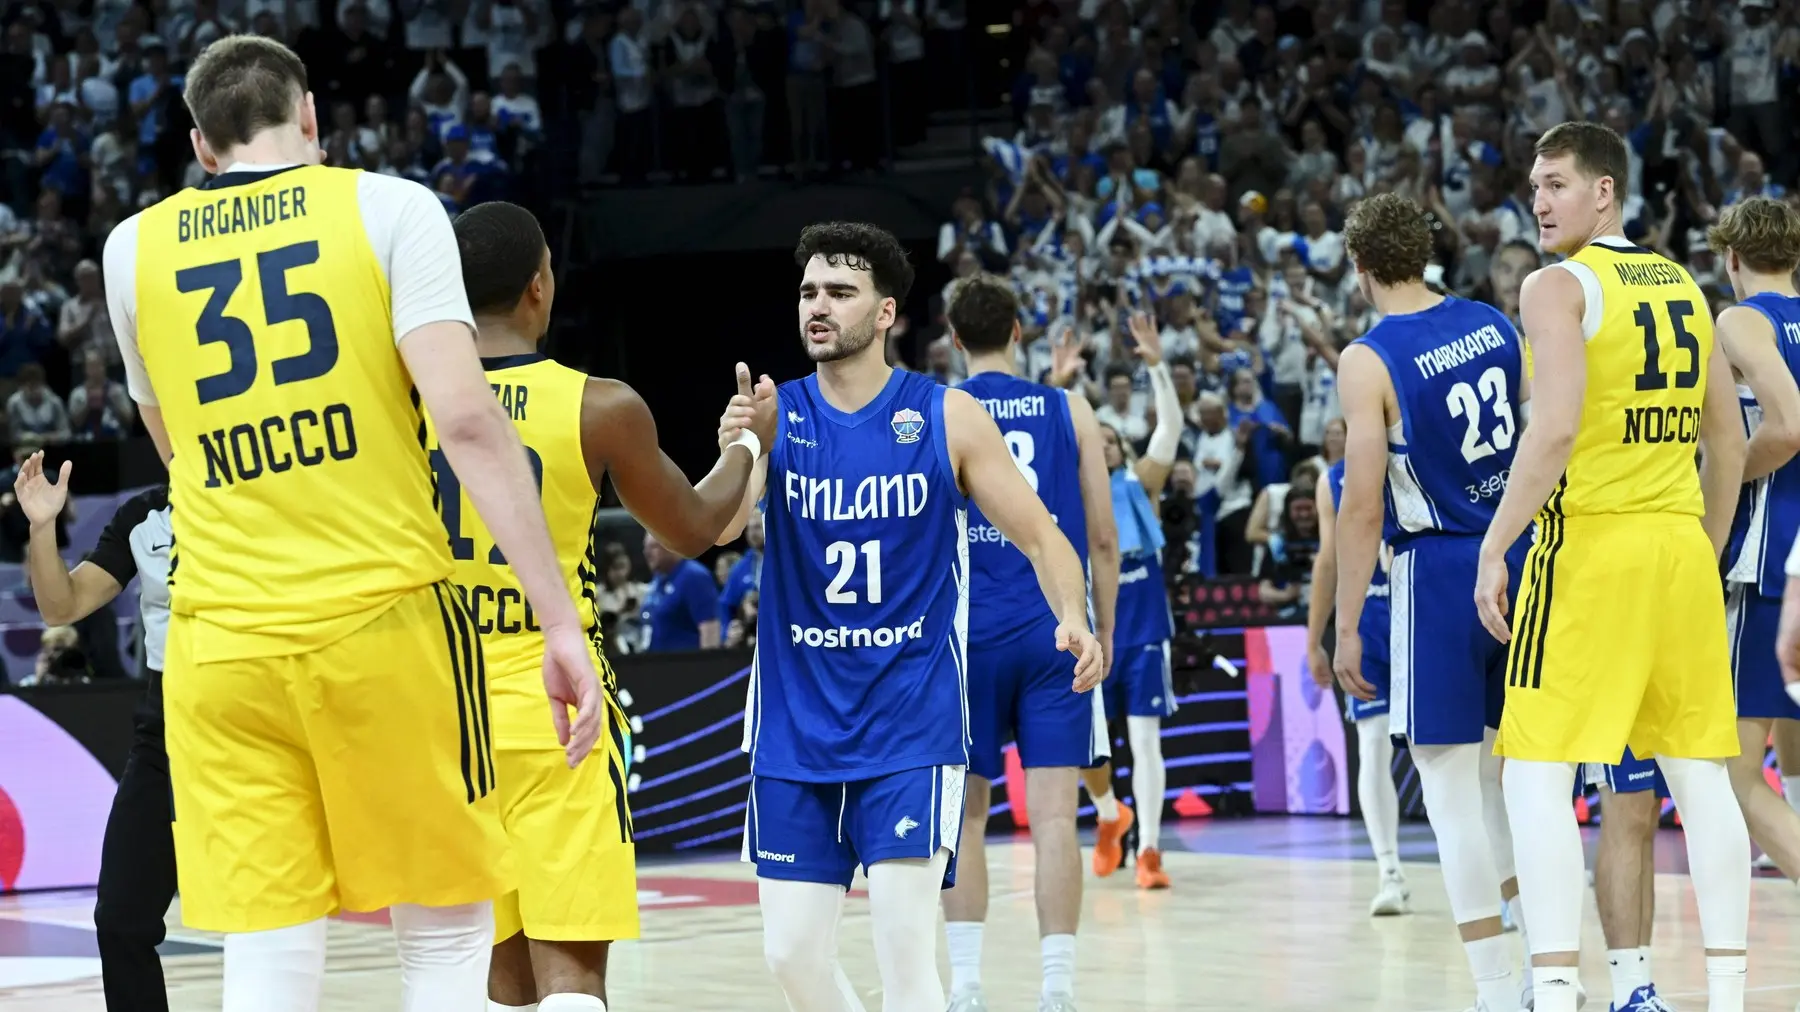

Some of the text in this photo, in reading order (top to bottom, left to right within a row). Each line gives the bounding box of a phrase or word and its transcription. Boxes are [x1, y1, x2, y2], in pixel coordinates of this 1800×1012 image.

[179, 186, 306, 242] BIRGANDER
[175, 241, 339, 404] 35
[1414, 324, 1505, 380] MARKKANEN
[1633, 300, 1700, 391] 15
[1446, 366, 1516, 464] 23
[1622, 406, 1700, 444] NOCCO
[199, 403, 357, 488] NOCCO
[785, 469, 928, 521] FINLAND
[825, 539, 882, 604] 21
[791, 616, 925, 648] postnord
